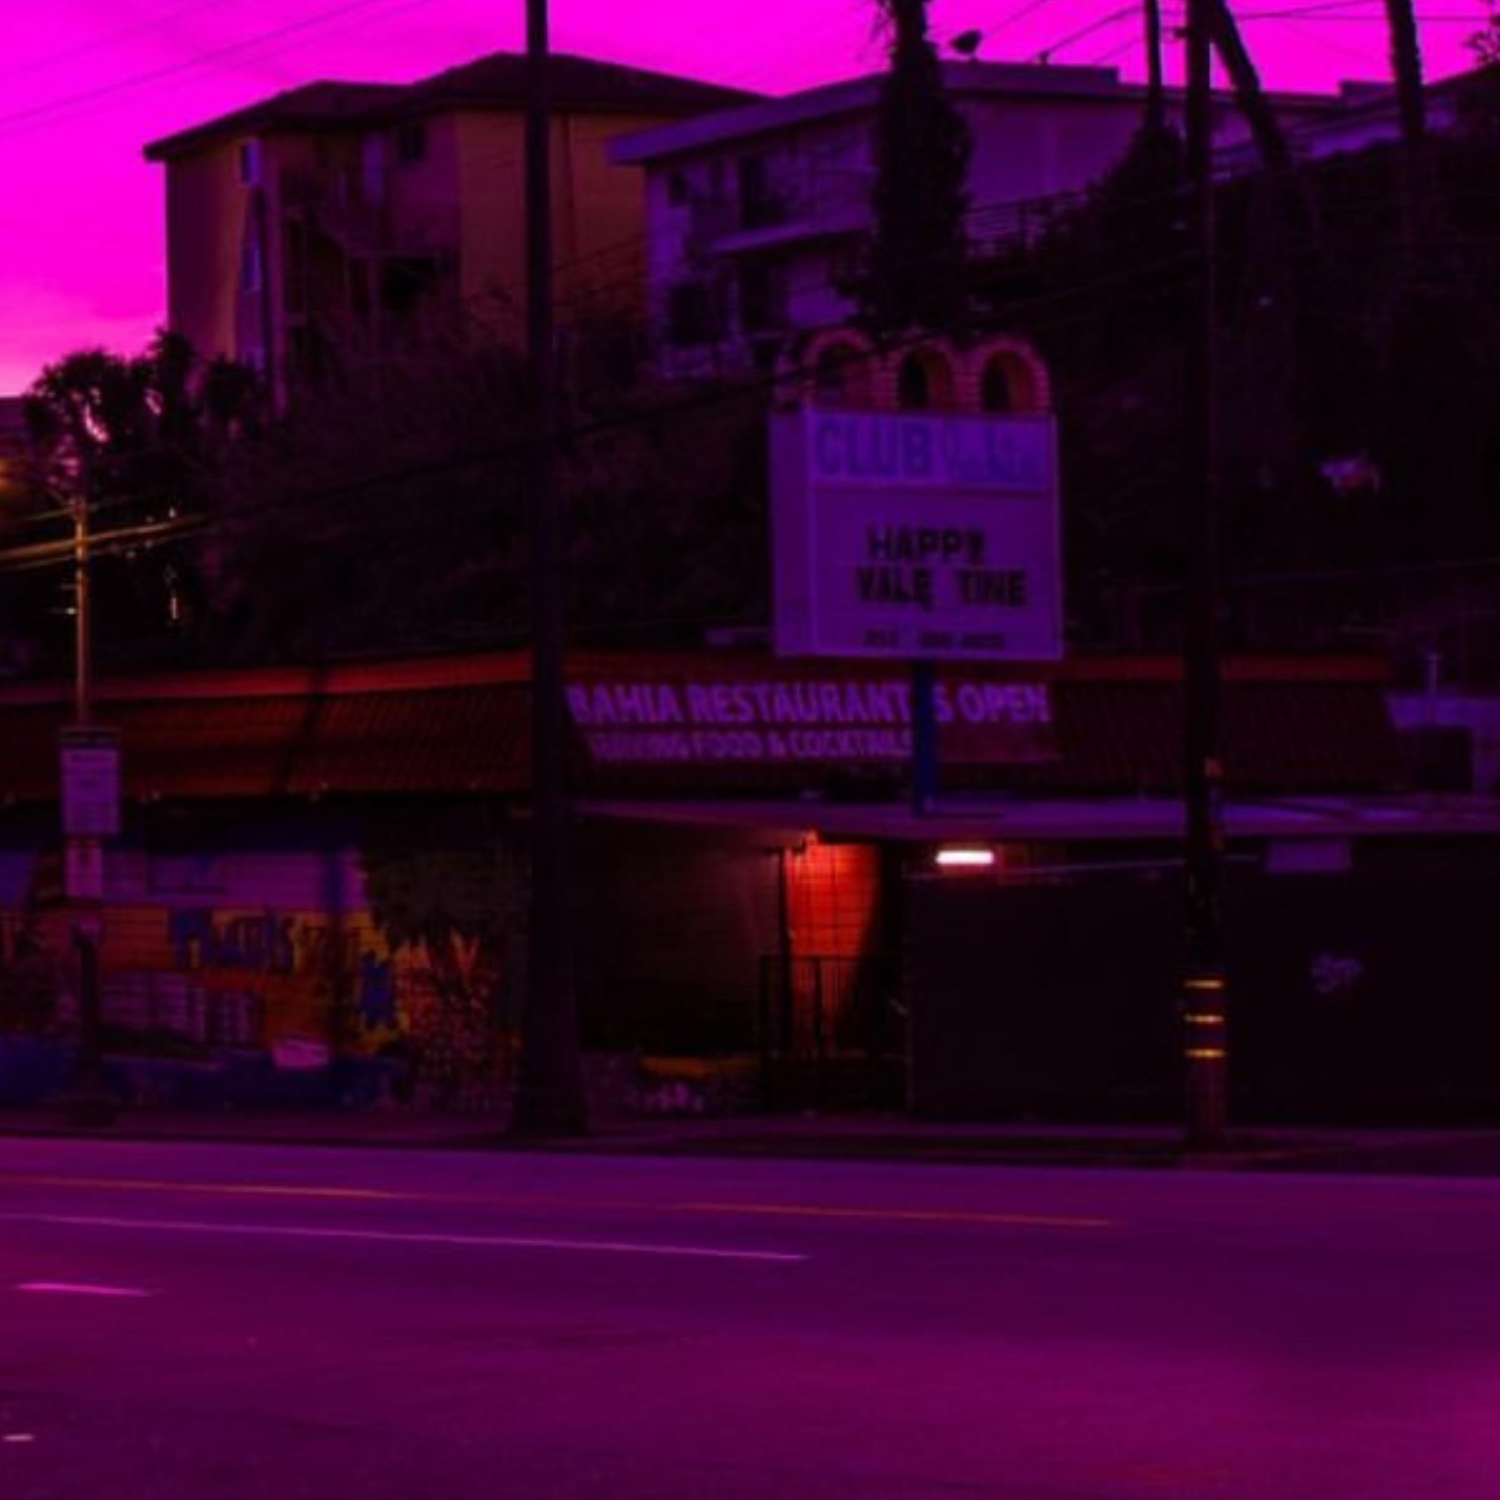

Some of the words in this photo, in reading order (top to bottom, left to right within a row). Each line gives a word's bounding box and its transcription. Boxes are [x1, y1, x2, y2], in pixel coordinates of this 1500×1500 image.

[816, 419, 932, 476] CLUB
[565, 682, 681, 724] BAHIA
[686, 683, 912, 724] RESTAURANT
[959, 682, 1050, 724] OPEN
